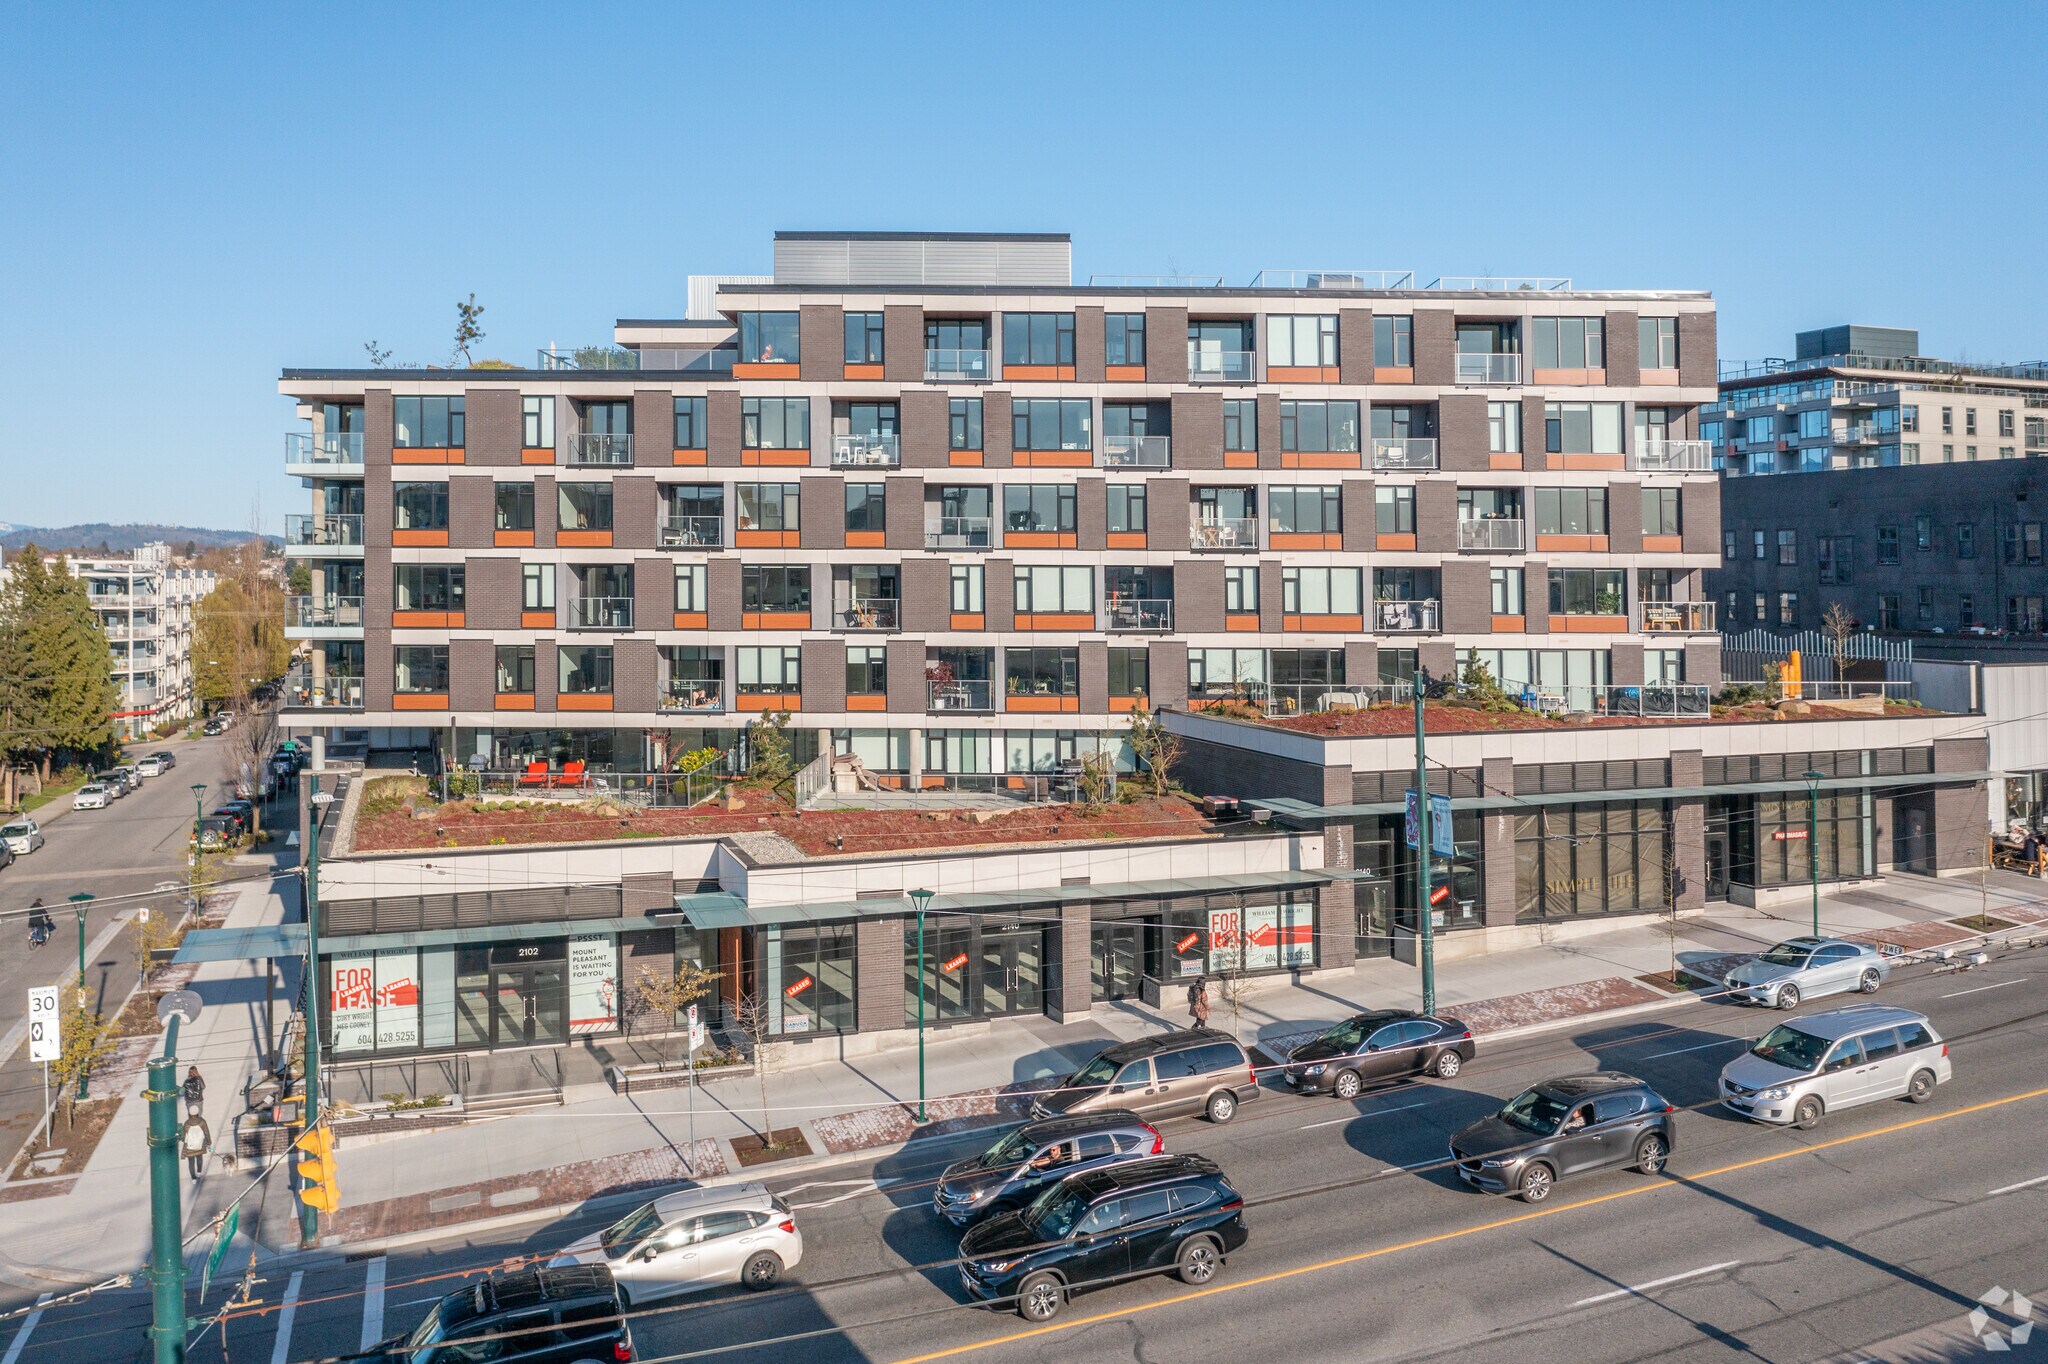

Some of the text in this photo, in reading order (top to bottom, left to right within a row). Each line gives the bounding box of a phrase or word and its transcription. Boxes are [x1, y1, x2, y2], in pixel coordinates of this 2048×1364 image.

[1431, 887, 1447, 902] LEASED
[1212, 912, 1239, 932] FOR
[1252, 925, 1269, 940] LEASED
[1180, 935, 1197, 951] LEASED
[1880, 944, 1903, 954] POWER
[518, 947, 538, 957] 2102
[573, 955, 607, 963] PLEASANT
[581, 962, 612, 970] WAITING
[946, 956, 966, 971] LEASED
[336, 968, 372, 990] FOR
[573, 970, 587, 978] FOR
[340, 984, 365, 998] LEASED
[386, 979, 410, 992] LEASED
[788, 980, 810, 995] LEASED
[33, 996, 55, 1012] 30
[335, 988, 397, 1011] LEASE
